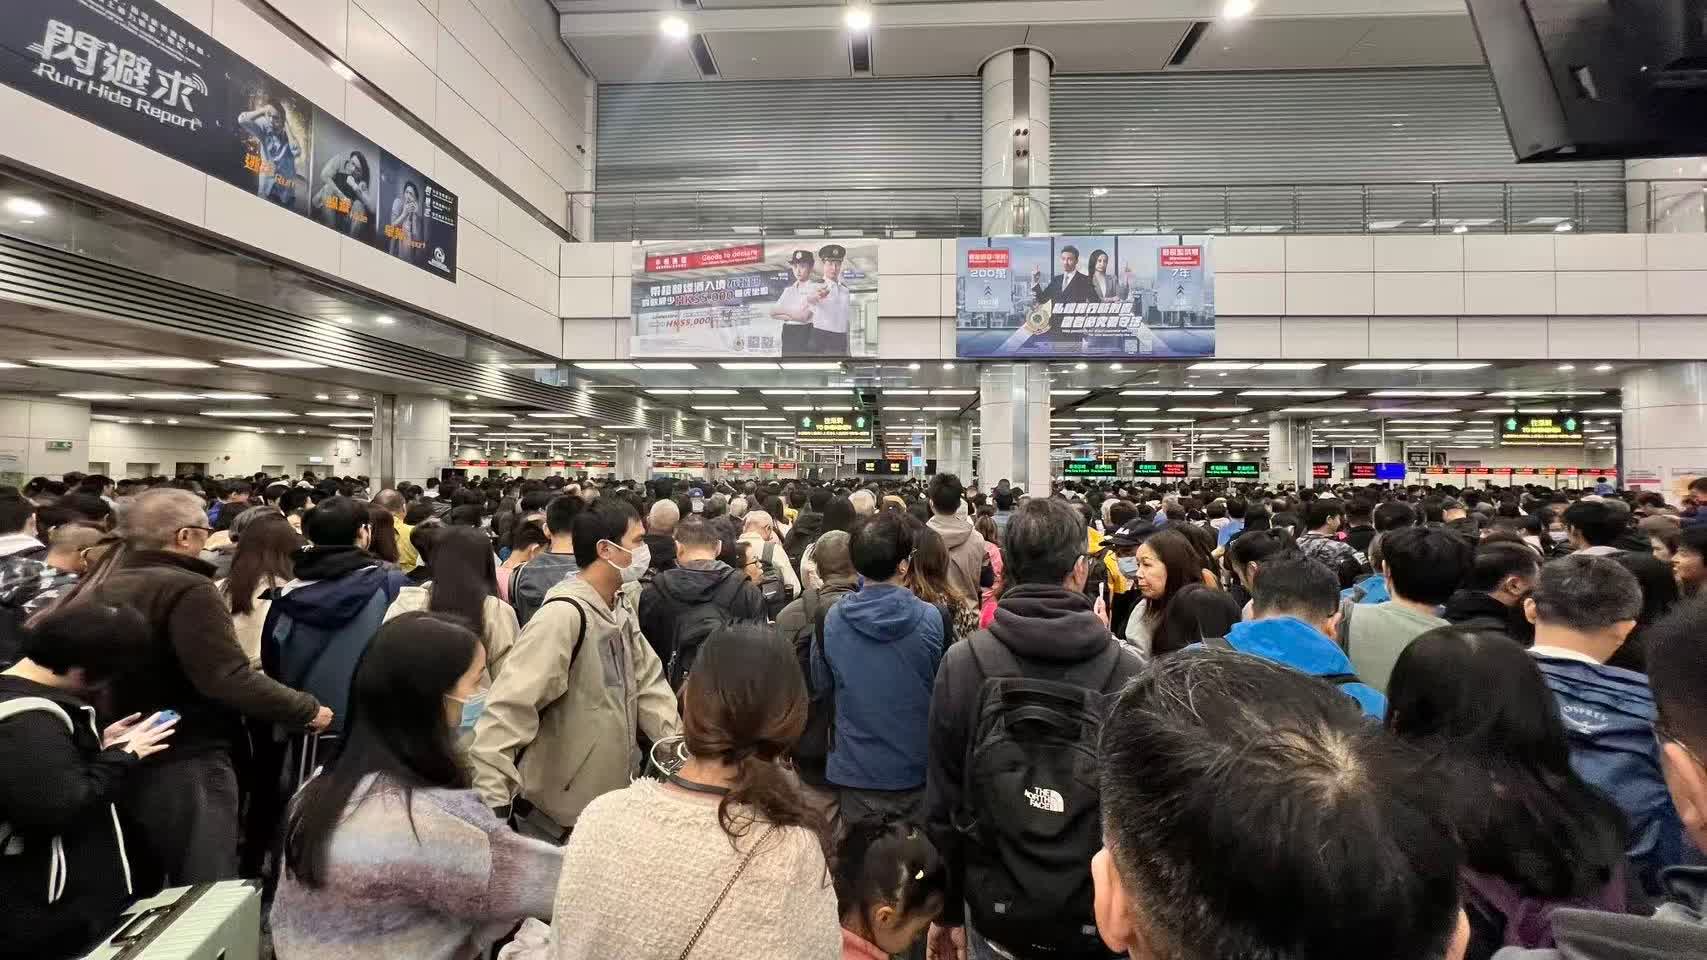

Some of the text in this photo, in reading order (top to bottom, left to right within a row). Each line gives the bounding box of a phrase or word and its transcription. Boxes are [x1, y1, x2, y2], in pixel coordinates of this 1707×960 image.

[38, 19, 197, 112] 閃避求
[36, 62, 202, 131] Run Hide Report
[702, 254, 722, 262] Goods
[732, 249, 758, 259] declare
[1024, 789, 1051, 804] NORTH
[1034, 786, 1051, 797] THE
[1029, 798, 1051, 810] FACE
